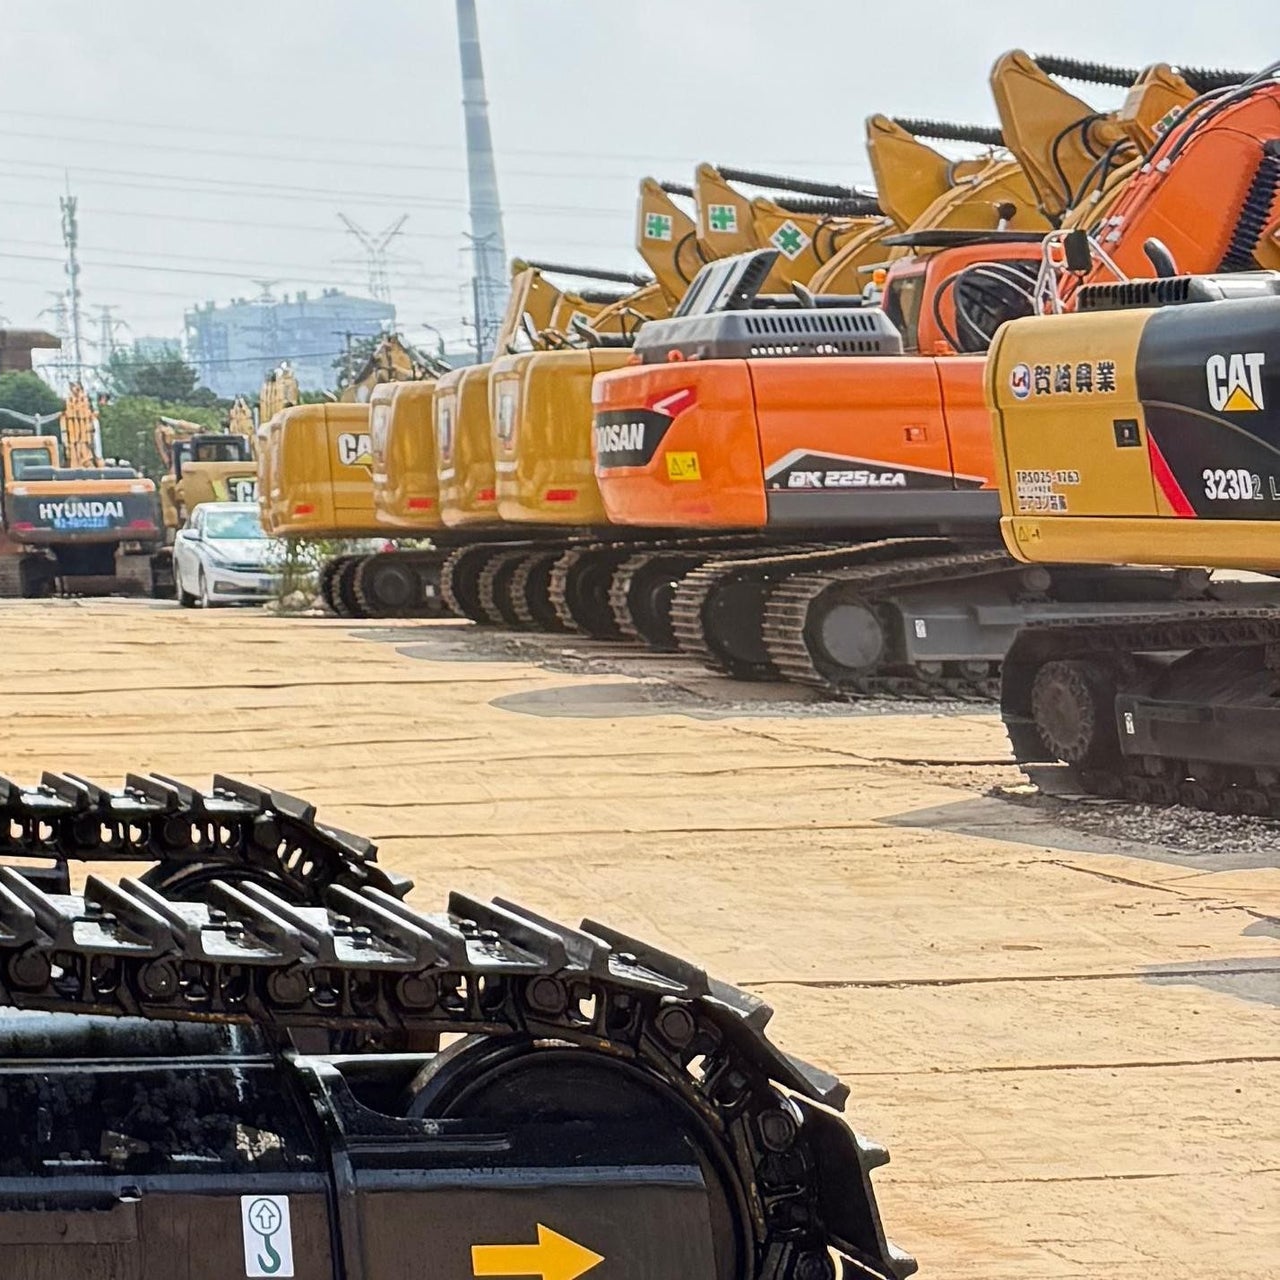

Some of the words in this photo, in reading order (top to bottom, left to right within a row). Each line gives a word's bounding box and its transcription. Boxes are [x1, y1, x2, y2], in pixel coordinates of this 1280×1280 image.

[1206, 353, 1265, 412] CAT
[338, 433, 371, 465] CA
[39, 502, 124, 519] HYUNDAI
